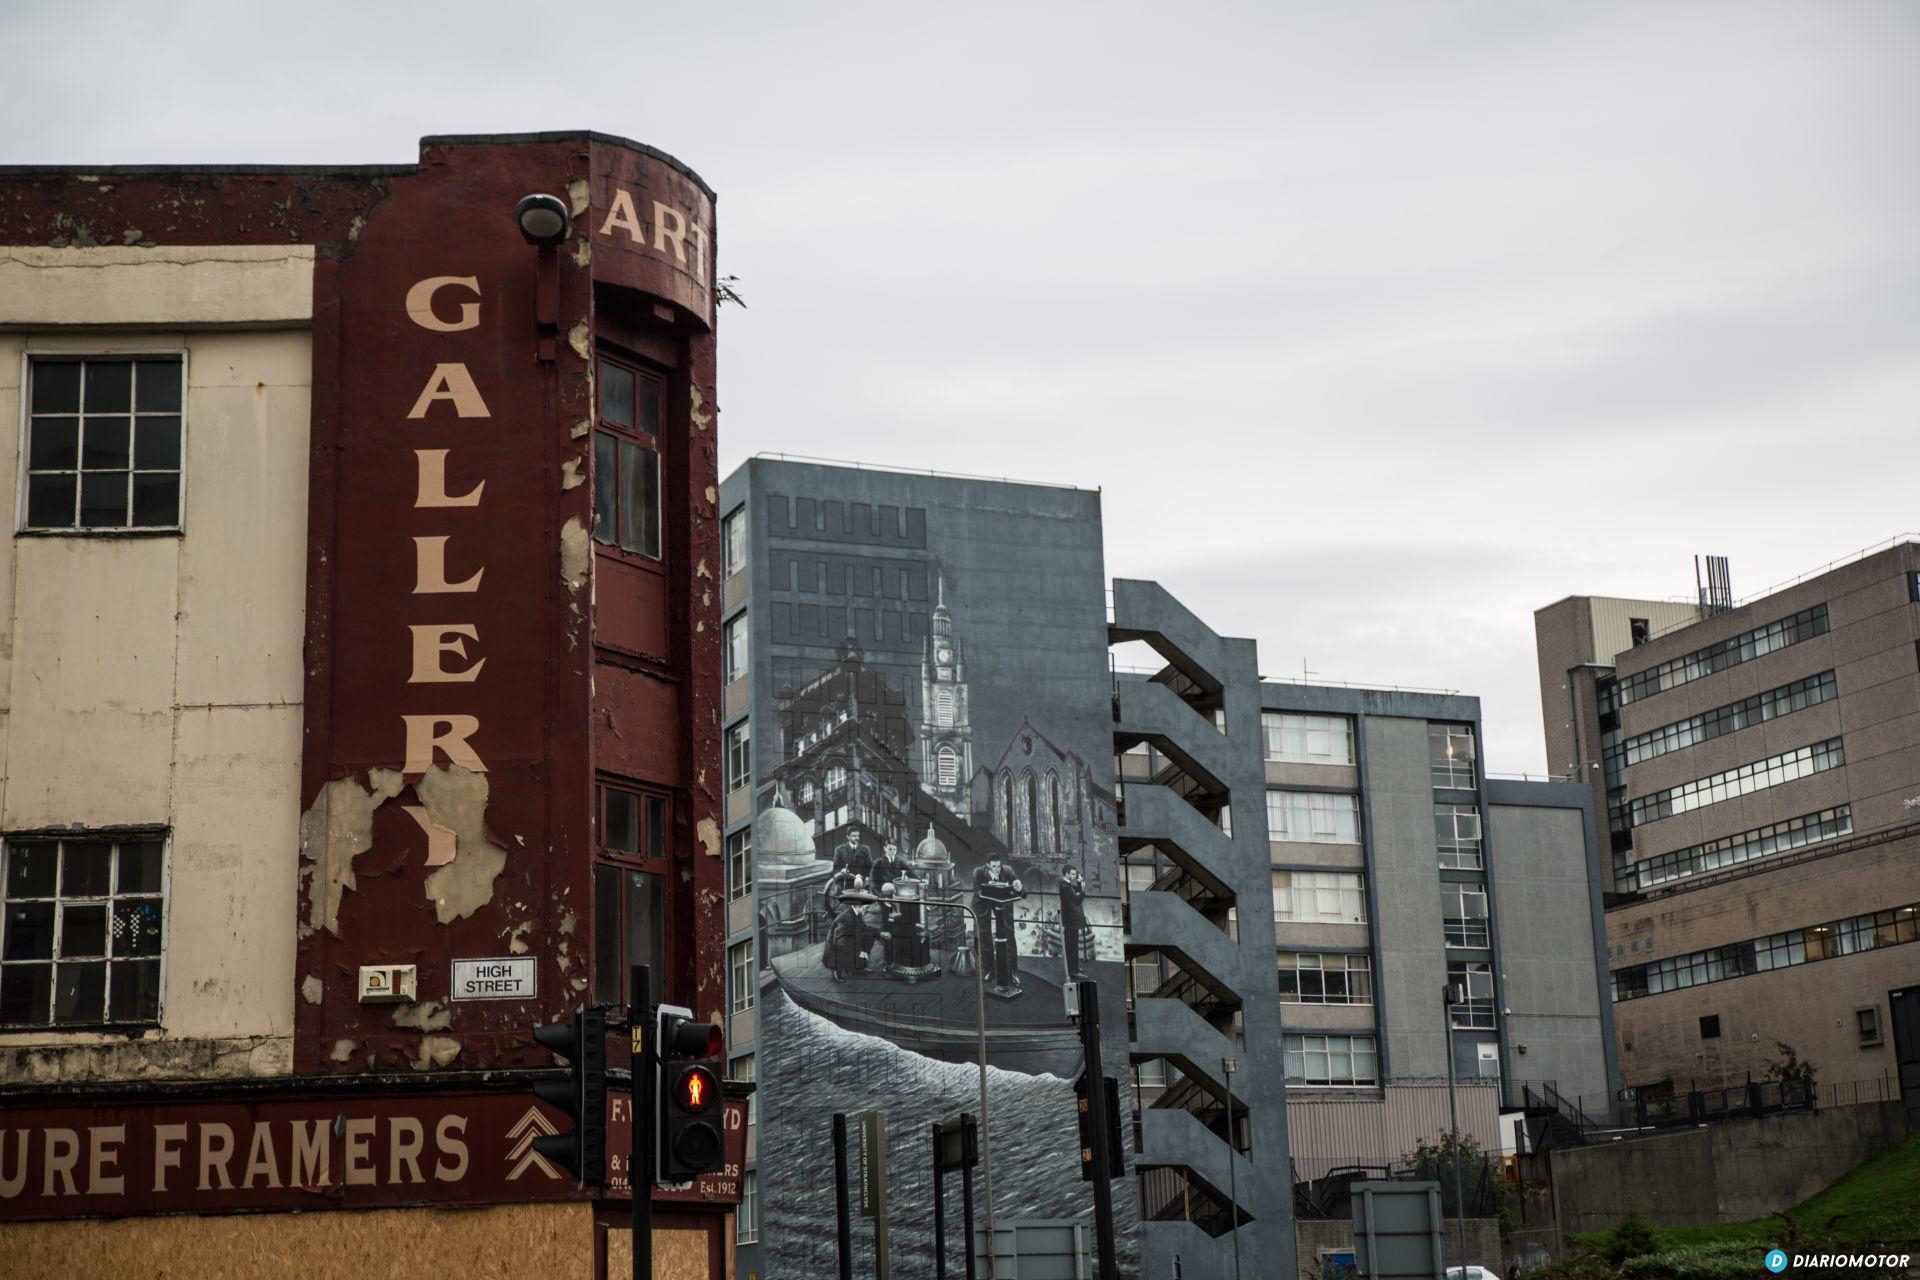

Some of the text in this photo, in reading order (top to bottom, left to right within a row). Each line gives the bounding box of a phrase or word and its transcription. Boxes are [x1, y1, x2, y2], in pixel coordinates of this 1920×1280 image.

[599, 189, 708, 279] ART
[400, 275, 492, 867] GALLERY
[466, 979, 523, 993] STREET
[476, 965, 512, 978] HIGH
[0, 1114, 470, 1199] URE FRAMERS
